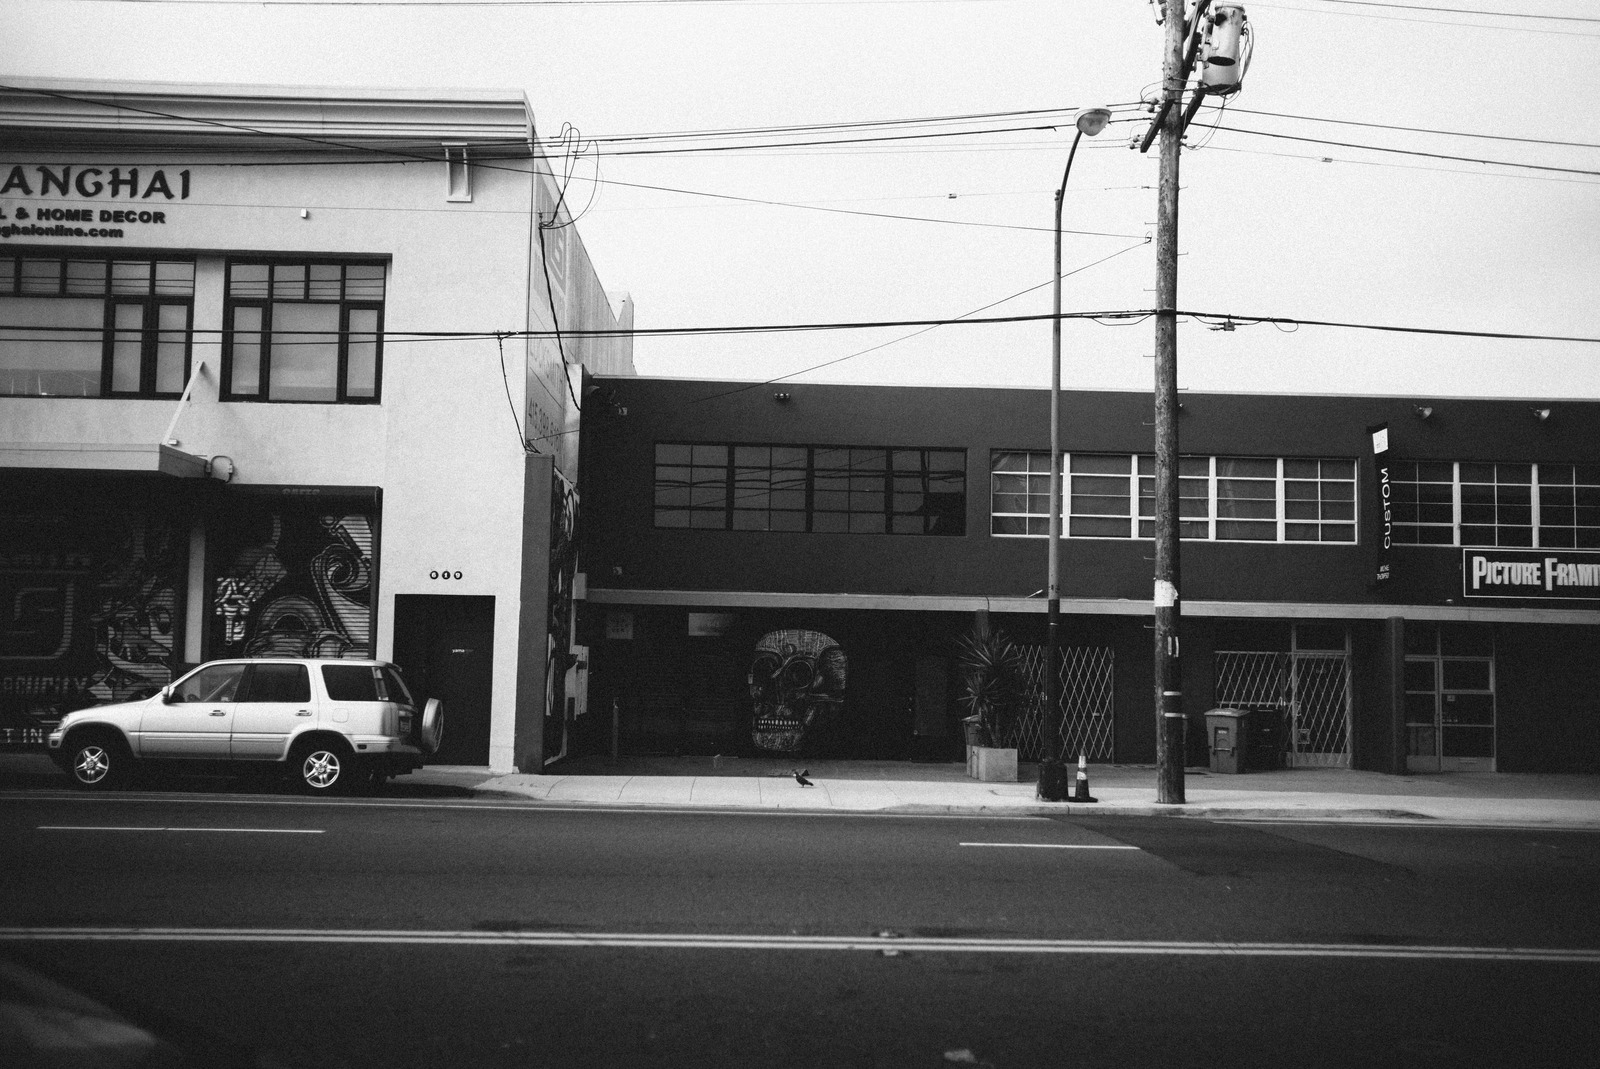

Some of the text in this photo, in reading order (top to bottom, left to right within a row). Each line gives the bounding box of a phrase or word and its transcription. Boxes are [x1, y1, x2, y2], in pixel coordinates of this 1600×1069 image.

[0, 165, 190, 200] ANGHAI
[0, 223, 124, 238] ghaionline.com
[15, 206, 30, 220] &
[37, 207, 93, 222] HOME
[99, 209, 166, 224] DECOR
[1380, 467, 1391, 549] CUSTOM
[1472, 556, 1600, 591] PICTURE FRAMI
